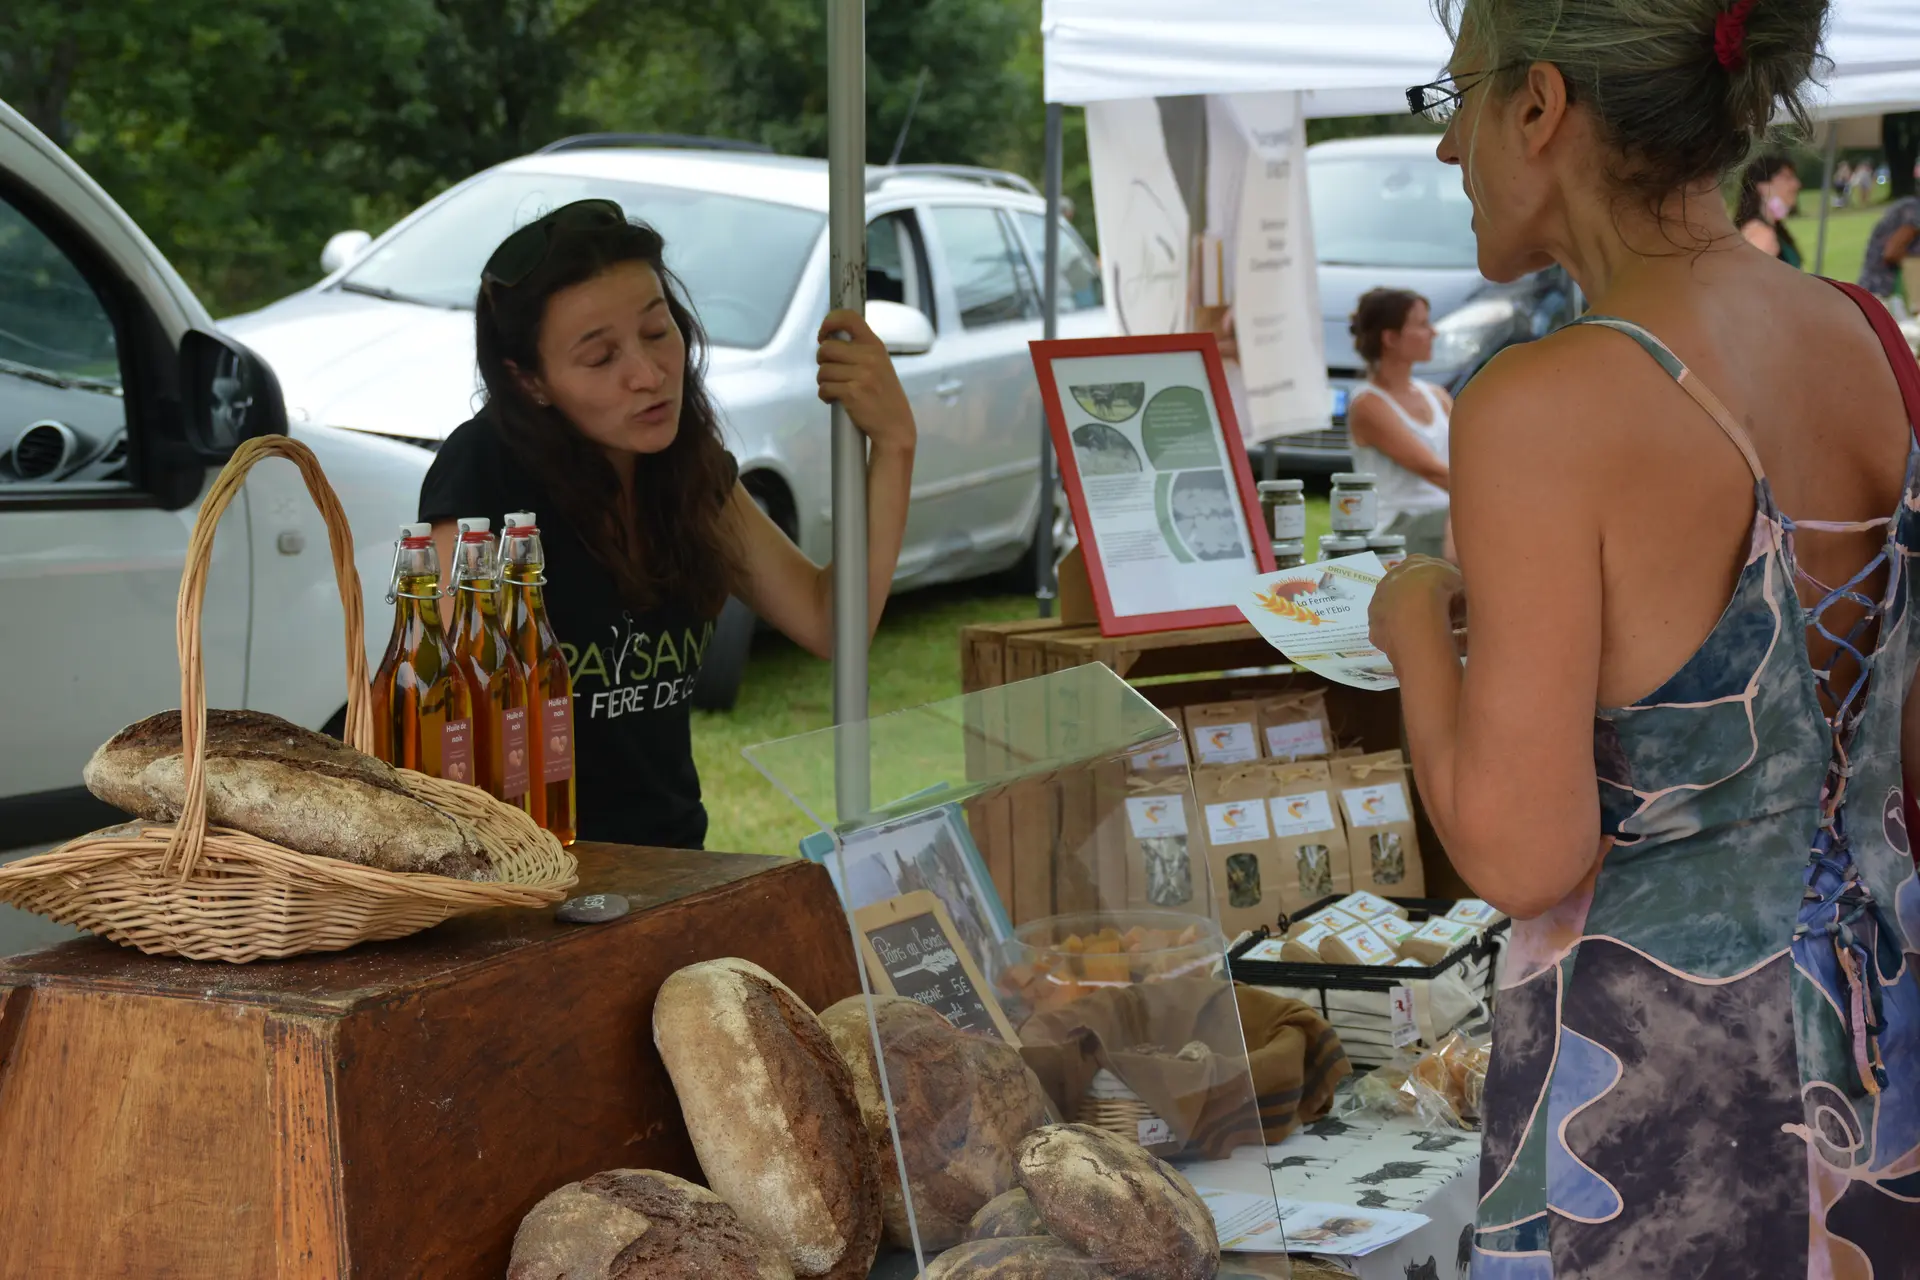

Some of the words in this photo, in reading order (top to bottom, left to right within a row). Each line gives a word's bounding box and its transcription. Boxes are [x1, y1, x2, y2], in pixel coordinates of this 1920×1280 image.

[1308, 596, 1336, 605] Ferme
[1314, 608, 1325, 617] de
[559, 614, 714, 688] PAYSAN
[548, 698, 562, 708] Huile
[590, 684, 649, 719] FIERE
[506, 712, 518, 721] Huile
[553, 709, 565, 717] noix
[446, 722, 461, 733] Huile
[511, 722, 521, 731] noix
[451, 735, 463, 743] noix
